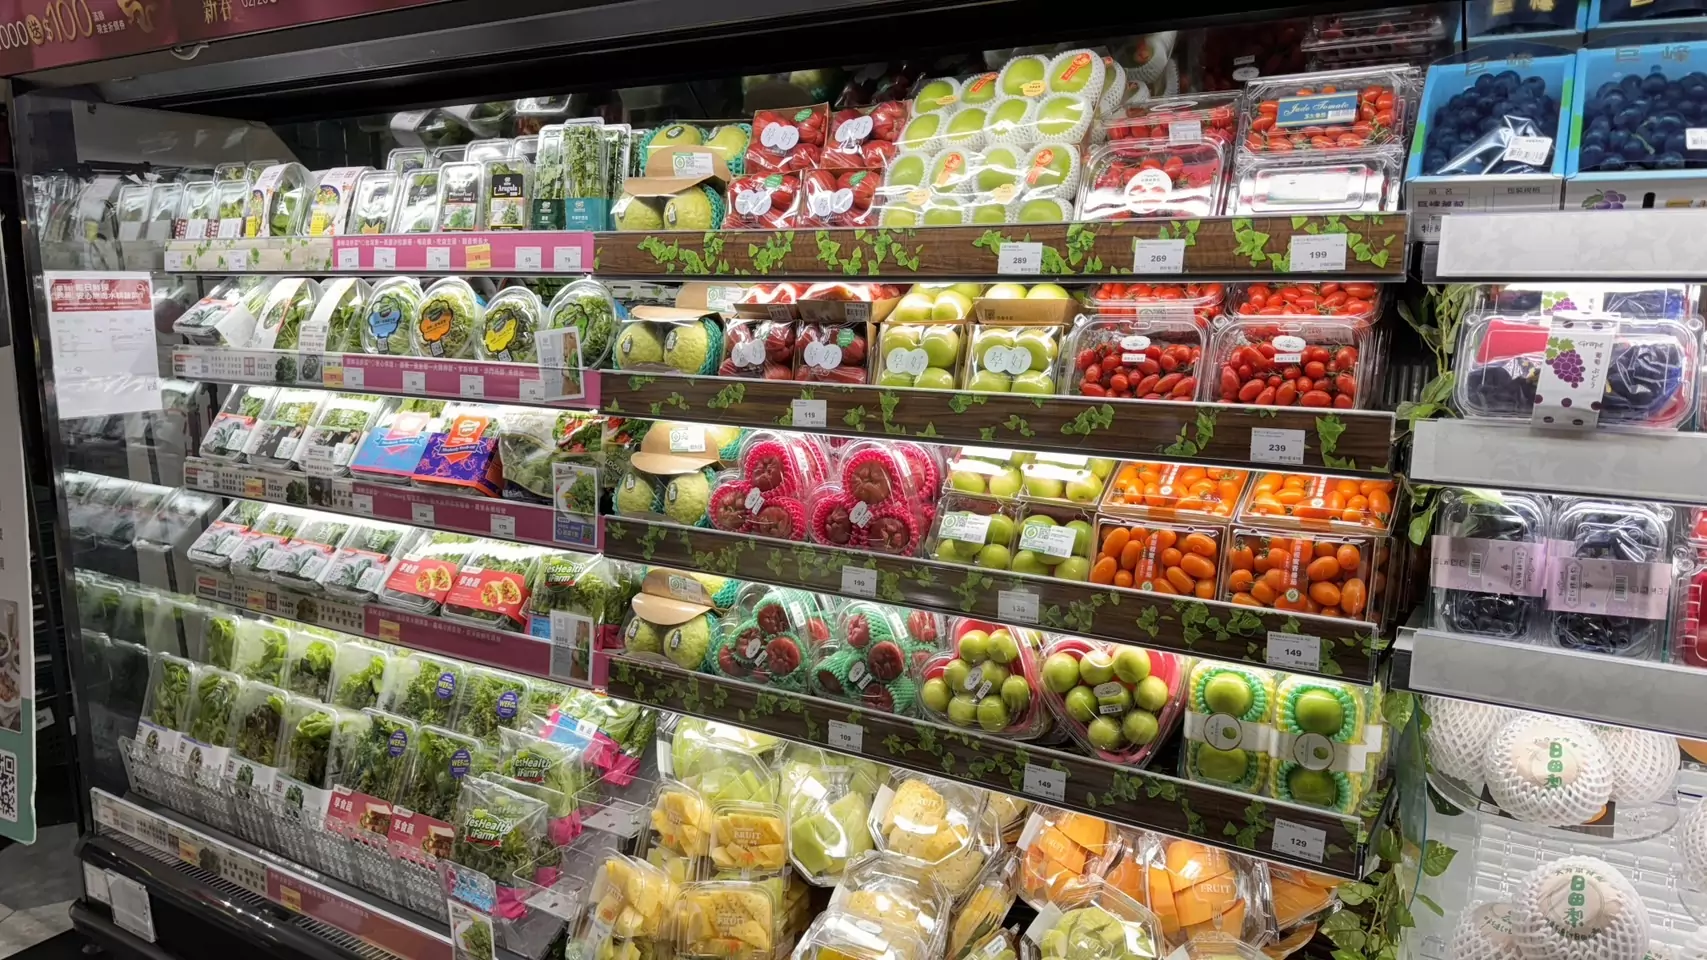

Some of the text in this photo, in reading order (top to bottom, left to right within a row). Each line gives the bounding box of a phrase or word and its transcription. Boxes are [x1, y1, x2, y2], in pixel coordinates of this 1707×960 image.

[43, 0, 93, 42] $100
[1284, 101, 1349, 117] Jade Tomato
[1012, 256, 1028, 264] 289
[1150, 254, 1167, 263] 269
[1308, 249, 1328, 260] 199
[1268, 444, 1286, 452] 239
[1284, 648, 1302, 657] 149
[512, 753, 551, 769] YesHealth
[517, 767, 539, 778] iFarm
[1037, 779, 1052, 789] 149
[394, 819, 415, 836] 享食蔬
[465, 814, 513, 833] YesHealth
[470, 828, 495, 841] iFarm
[733, 831, 761, 840] FRUIT
[1290, 837, 1308, 848] 129
[1200, 884, 1231, 894] FRUIT
[716, 918, 745, 926] FRUIT
